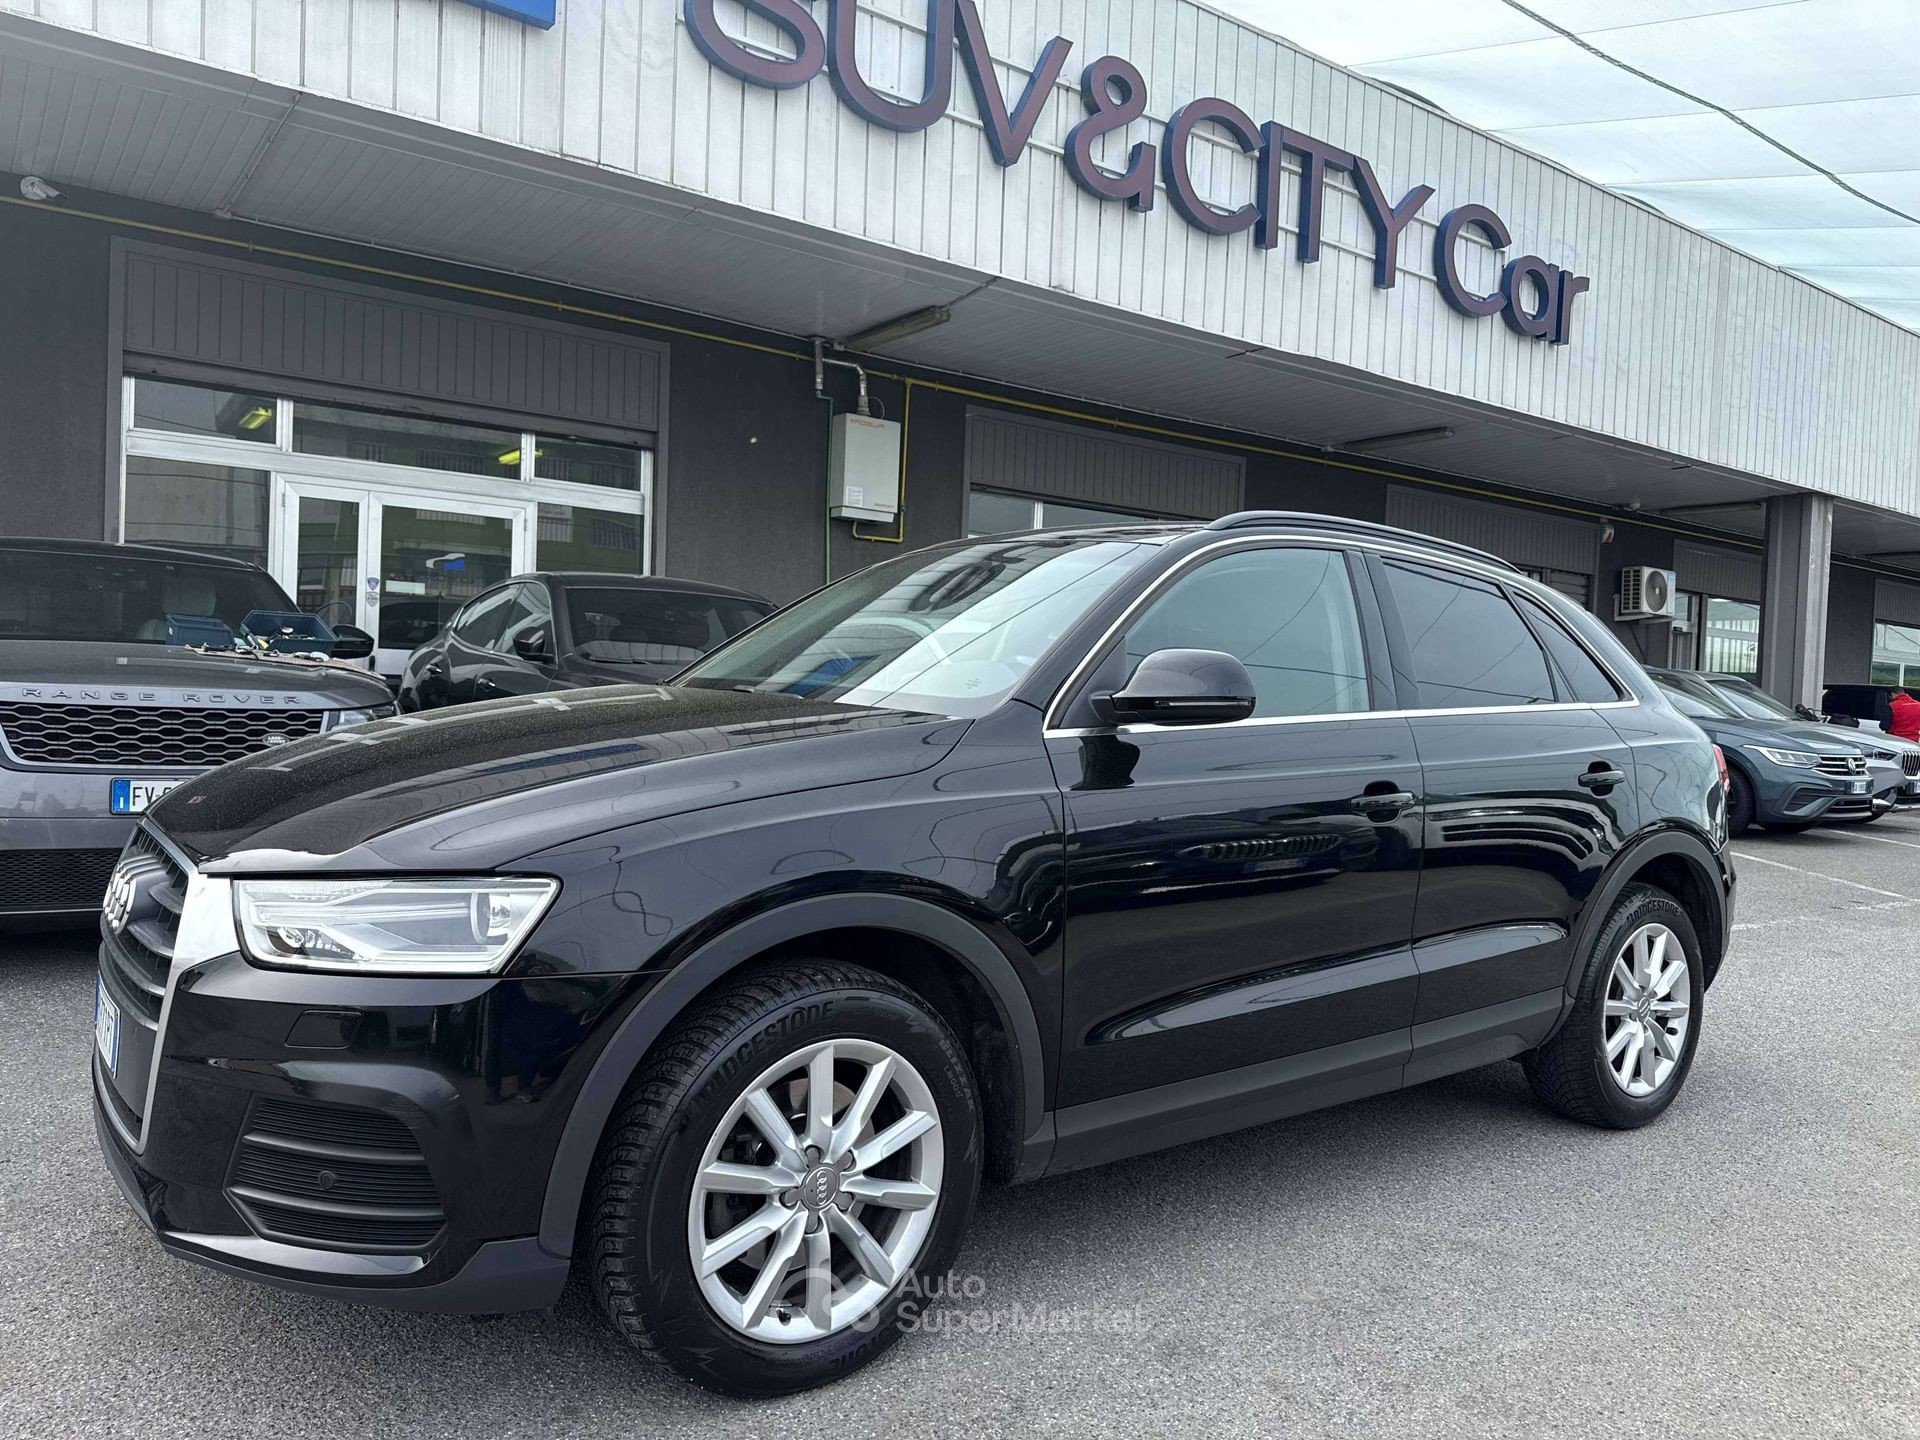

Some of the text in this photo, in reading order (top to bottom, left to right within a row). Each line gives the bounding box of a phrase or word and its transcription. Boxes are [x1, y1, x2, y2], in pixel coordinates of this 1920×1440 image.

[1434, 203, 1590, 346] Car
[22, 687, 300, 704] RANGE ROVER
